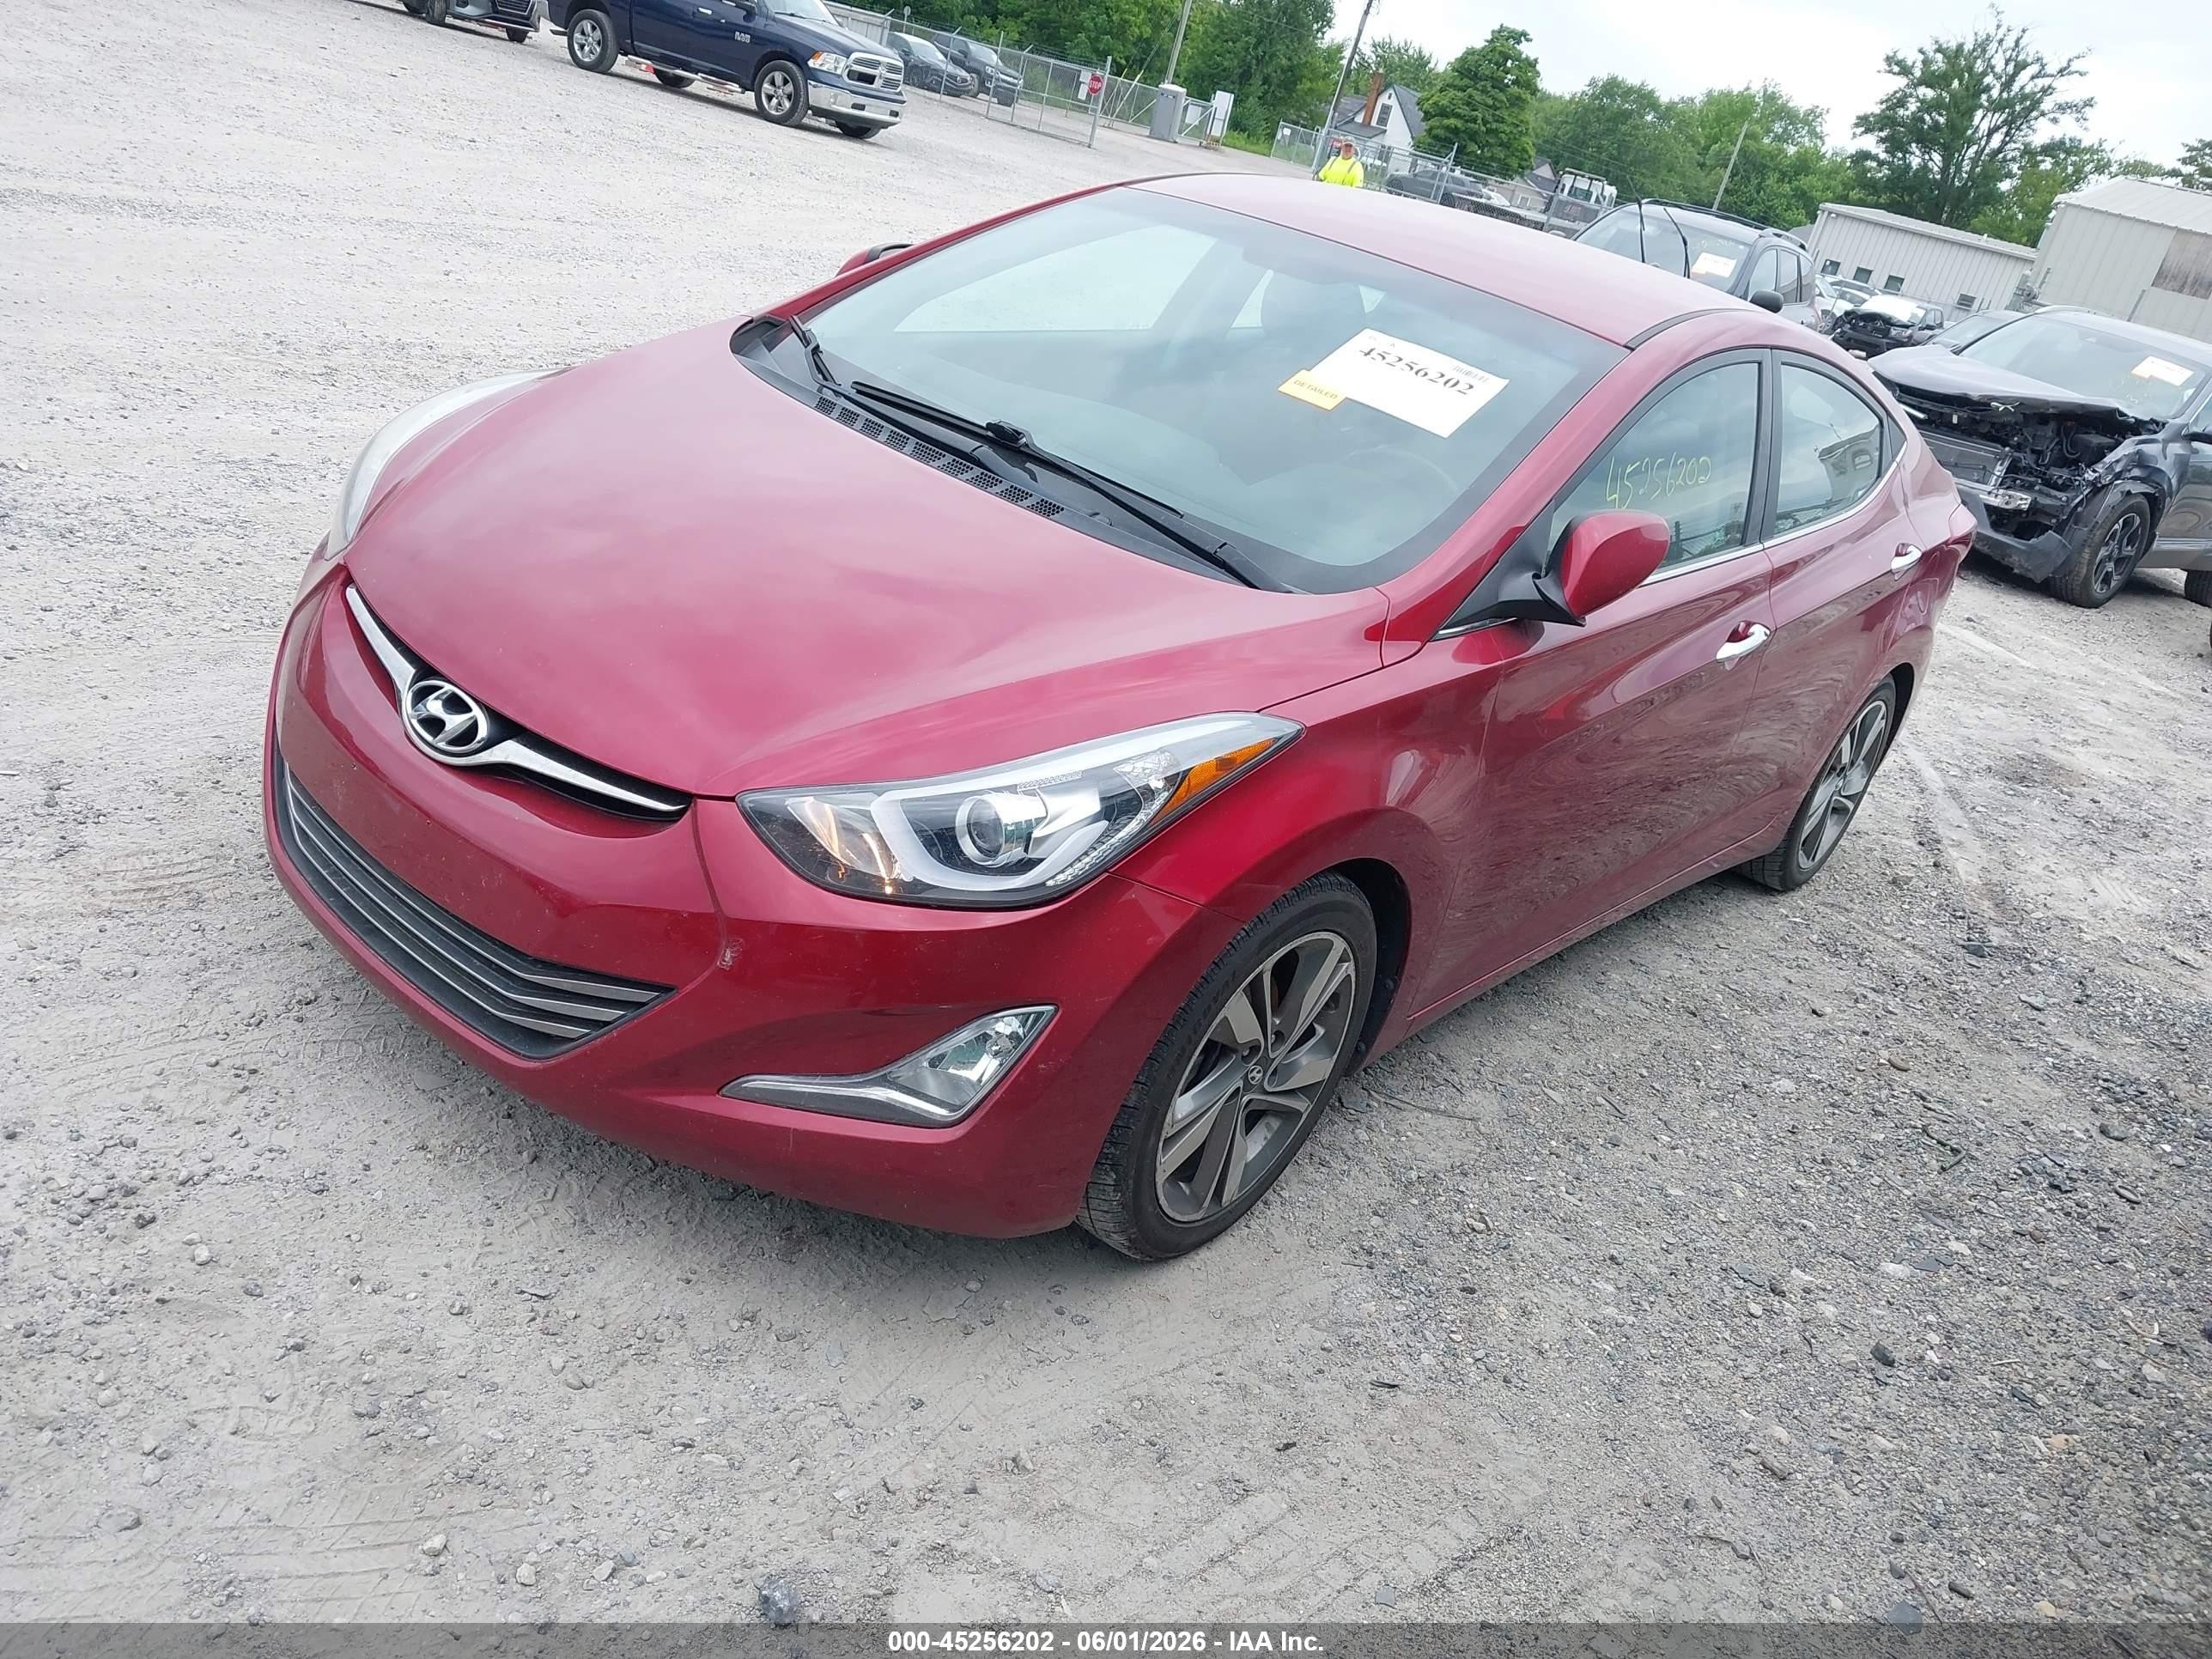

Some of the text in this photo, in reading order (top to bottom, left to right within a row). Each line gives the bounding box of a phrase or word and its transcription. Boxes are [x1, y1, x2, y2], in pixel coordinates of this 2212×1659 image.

[1090, 81, 1102, 89] STOP
[1358, 347, 1474, 396] 45256202
[1293, 380, 1338, 399] DETAILED
[1606, 452, 1711, 509] 45256202
